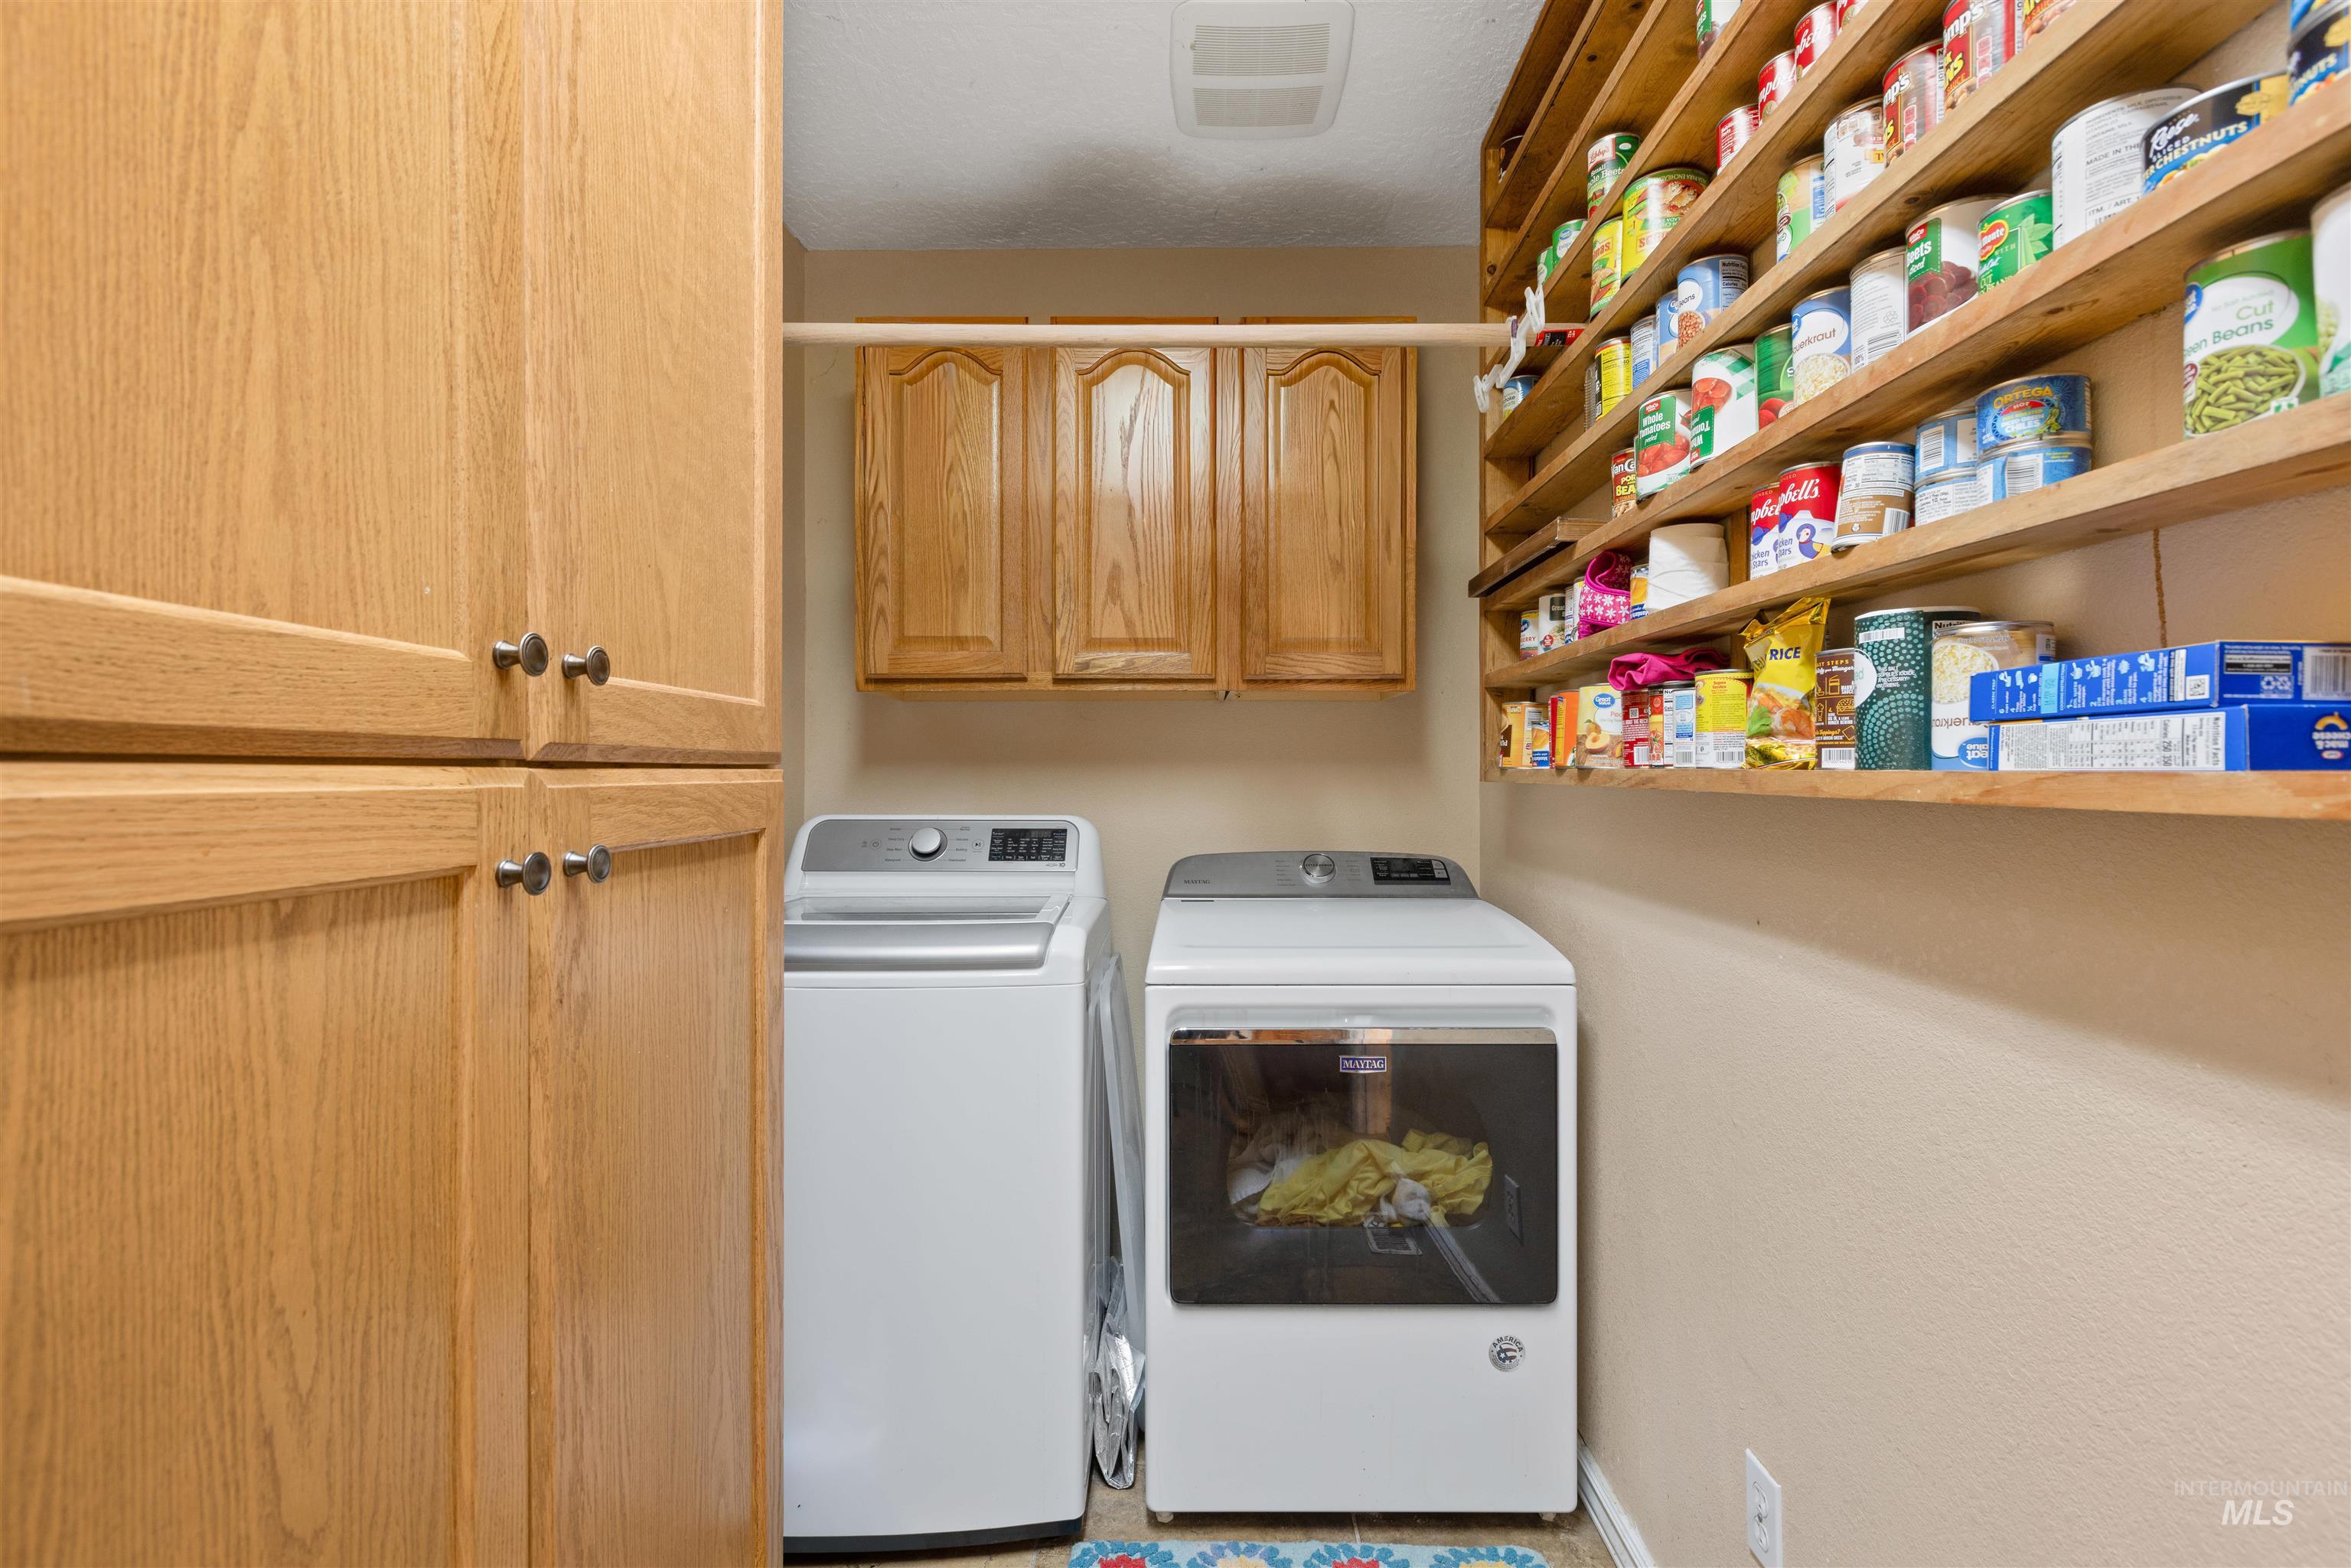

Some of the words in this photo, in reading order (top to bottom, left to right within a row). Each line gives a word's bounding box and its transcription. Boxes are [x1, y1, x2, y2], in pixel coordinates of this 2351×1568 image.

[2149, 112, 2199, 158] Reese
[2086, 152, 2111, 166] MADE
[2124, 142, 2142, 152] THE
[2152, 136, 2191, 162] SLICED
[2155, 121, 2249, 171] CHESTNUTS
[1591, 163, 1606, 177] Small
[2235, 299, 2275, 321] Cut
[2212, 318, 2274, 345] Beans
[1993, 385, 2053, 409] ORTEGA
[2013, 401, 2030, 409] HOT
[1642, 412, 1663, 428] Whole
[2004, 419, 2040, 433] CHILES
[1639, 420, 1671, 440] Tomatoes
[1778, 546, 1792, 558] Stars
[1753, 559, 1769, 569] Stars
[1769, 647, 1801, 660] RICE
[2162, 719, 2170, 738] Calories
[2212, 716, 2220, 746] Nutrition
[2162, 740, 2171, 752] 250
[2162, 755, 2172, 767] 350
[2212, 747, 2220, 766] Facts
[1342, 1059, 1384, 1069] MAYTAG
[1492, 1335, 1524, 1353] AMERICA
